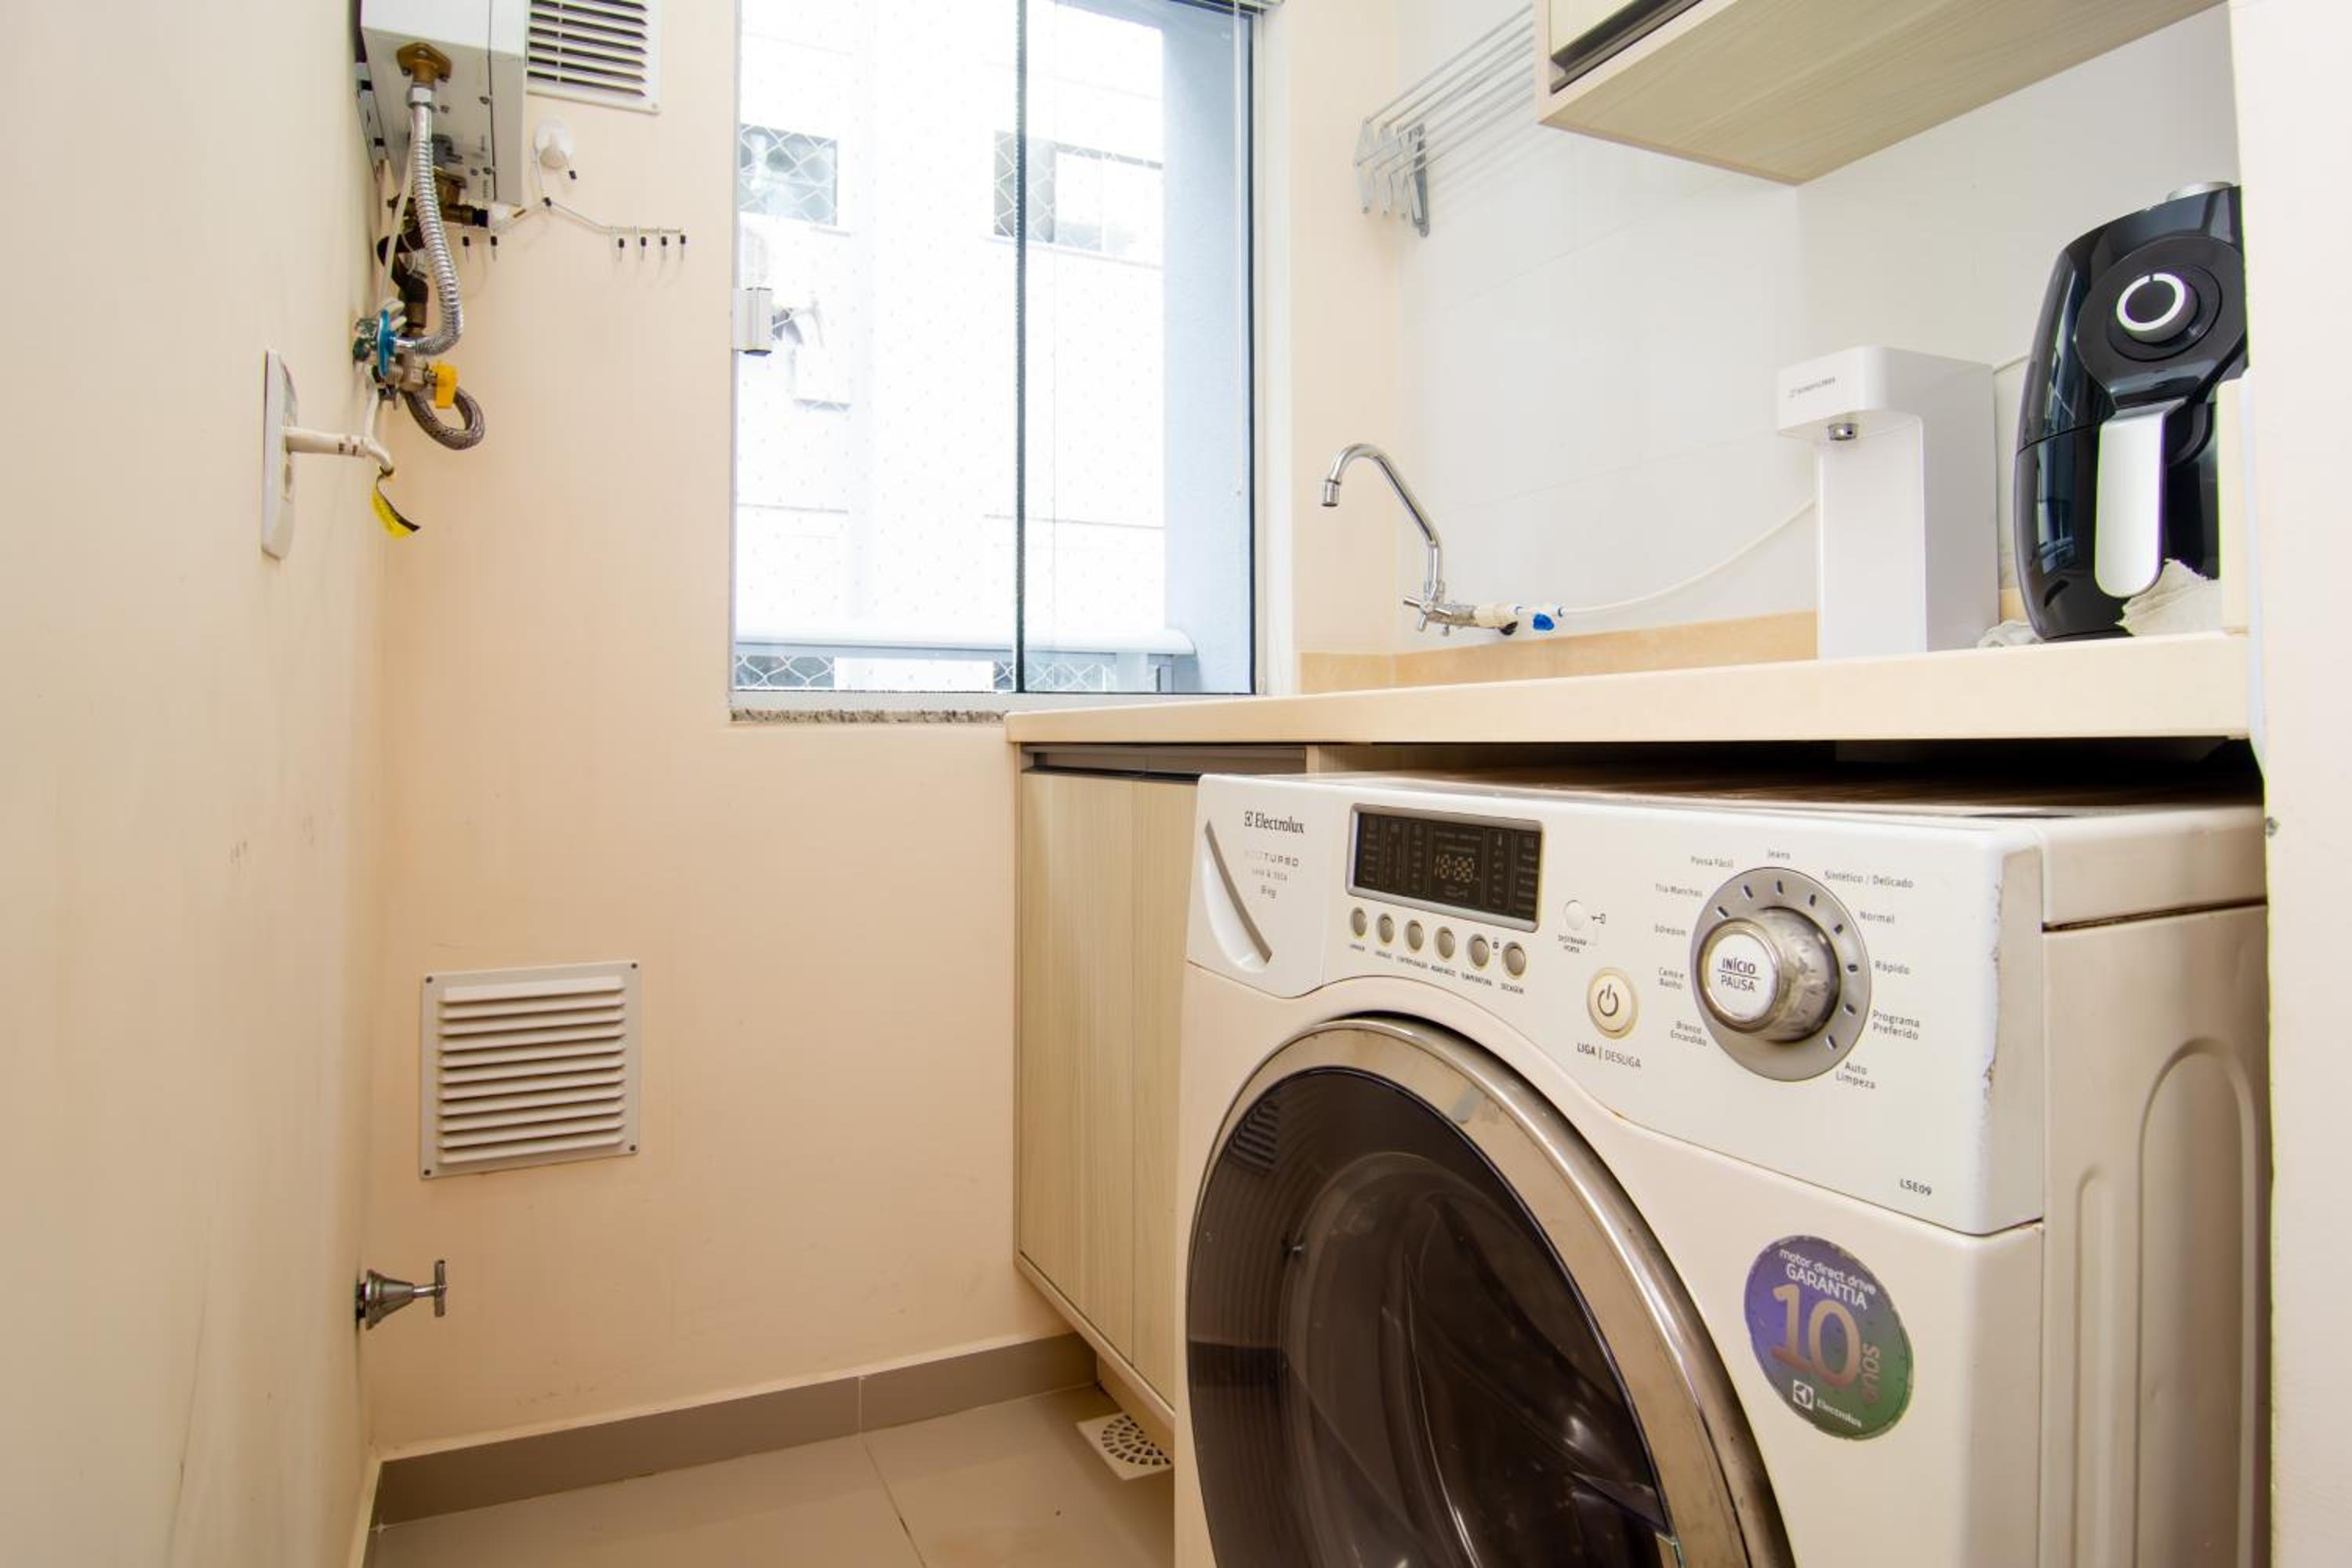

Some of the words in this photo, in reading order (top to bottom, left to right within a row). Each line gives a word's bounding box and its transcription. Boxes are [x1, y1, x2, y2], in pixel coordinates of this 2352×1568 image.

[1254, 812, 1305, 833] Electrolux
[1690, 855, 1714, 867] Passa
[1767, 848, 1791, 860] Jeans
[1824, 870, 1864, 884] Sintético
[1872, 875, 1915, 889] Delicado
[1859, 911, 1896, 924] Normal
[1658, 966, 1679, 978] Cama
[1722, 956, 1756, 975] INÍCIO
[1875, 960, 1911, 975] Rápido
[1659, 977, 1683, 990] Banho
[1720, 975, 1756, 993] PAUSA
[1675, 1021, 1702, 1034] Branco
[1872, 1009, 1921, 1029] Programa
[1670, 1029, 1708, 1047] Encardido
[1872, 1021, 1919, 1041] Preferido
[1577, 1042, 1596, 1056] LIGA
[1605, 1049, 1642, 1068] DESLIGA
[1844, 1062, 1868, 1076] Auto
[1835, 1070, 1877, 1091] Limpeza
[1899, 1178, 1933, 1196] LSE09
[1779, 1248, 1813, 1269] motor
[1813, 1262, 1846, 1283] direct
[1847, 1275, 1878, 1296] drive
[1786, 1262, 1869, 1312] GARANTIA
[1770, 1283, 1861, 1389] 10
[1816, 1398, 1863, 1428] Electrolux
